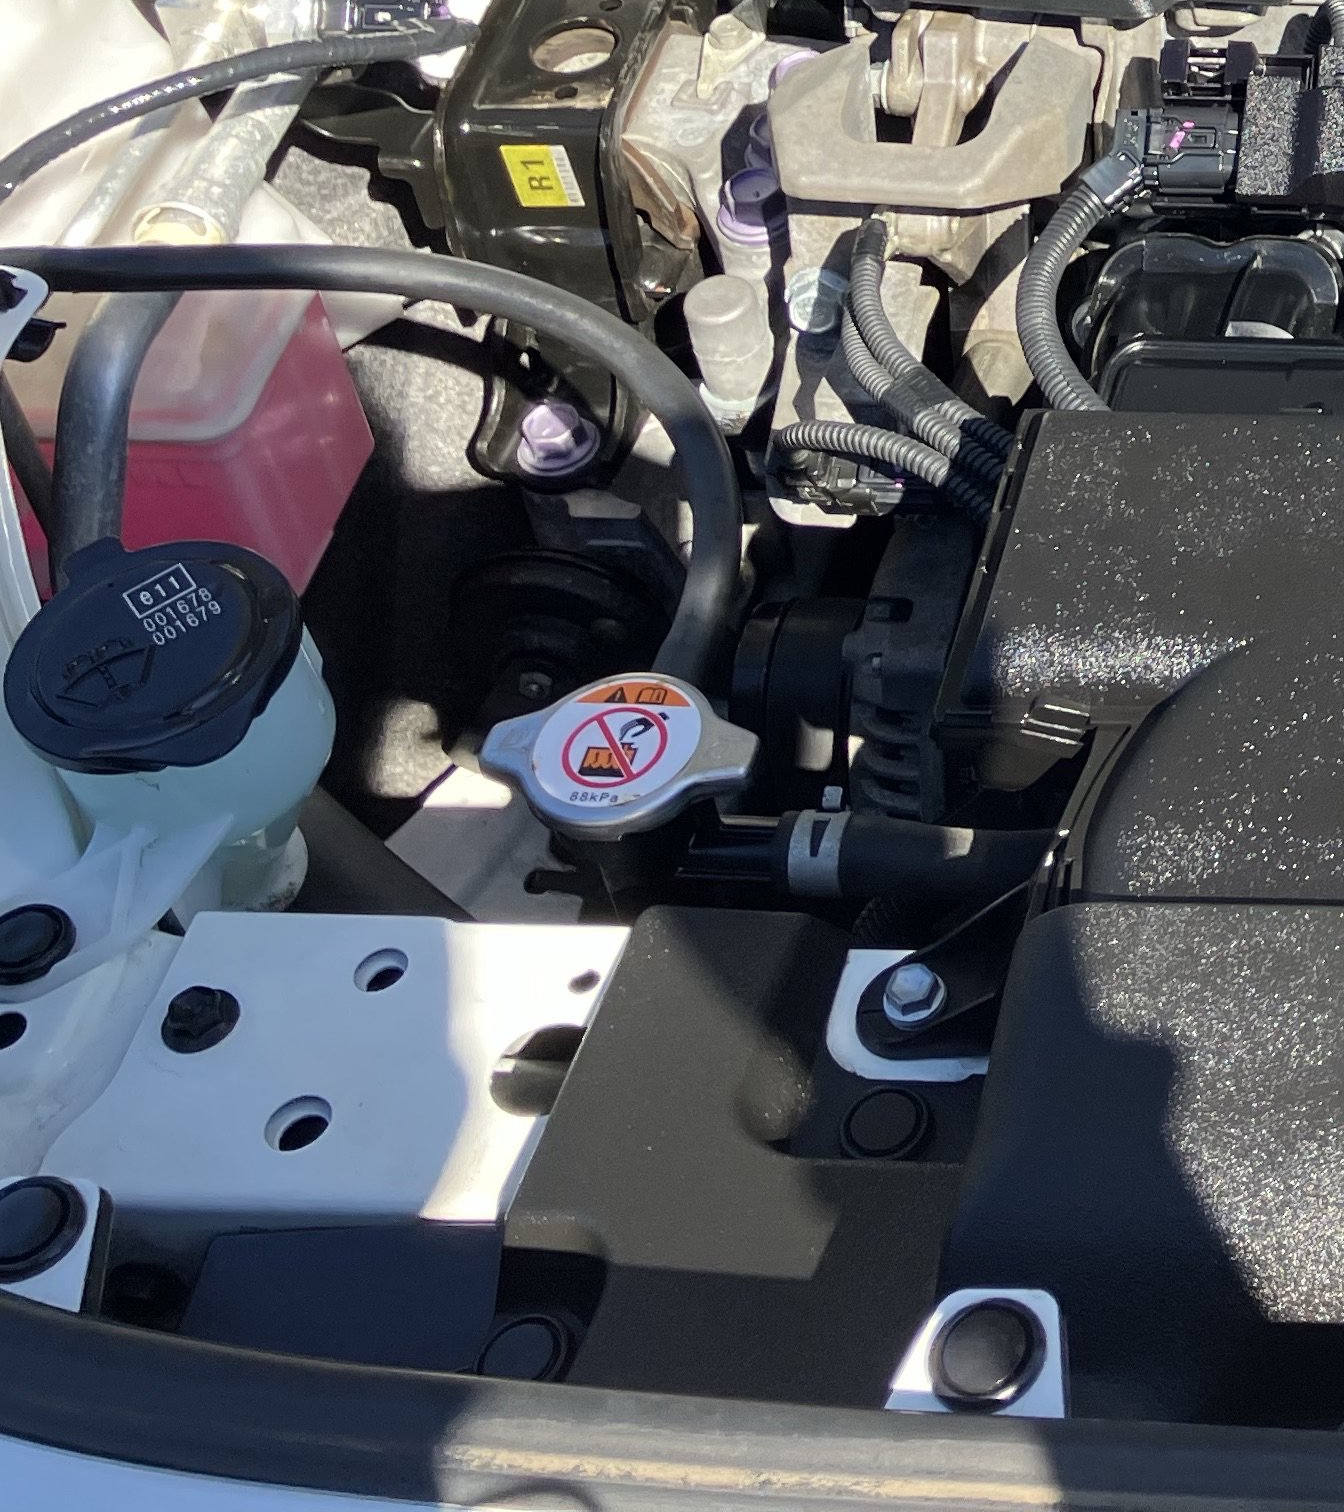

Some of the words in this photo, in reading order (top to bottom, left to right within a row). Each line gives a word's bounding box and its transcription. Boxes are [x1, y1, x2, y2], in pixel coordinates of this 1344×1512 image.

[520, 159, 554, 190] R1
[143, 587, 212, 632] 001678
[153, 600, 221, 645] 001679
